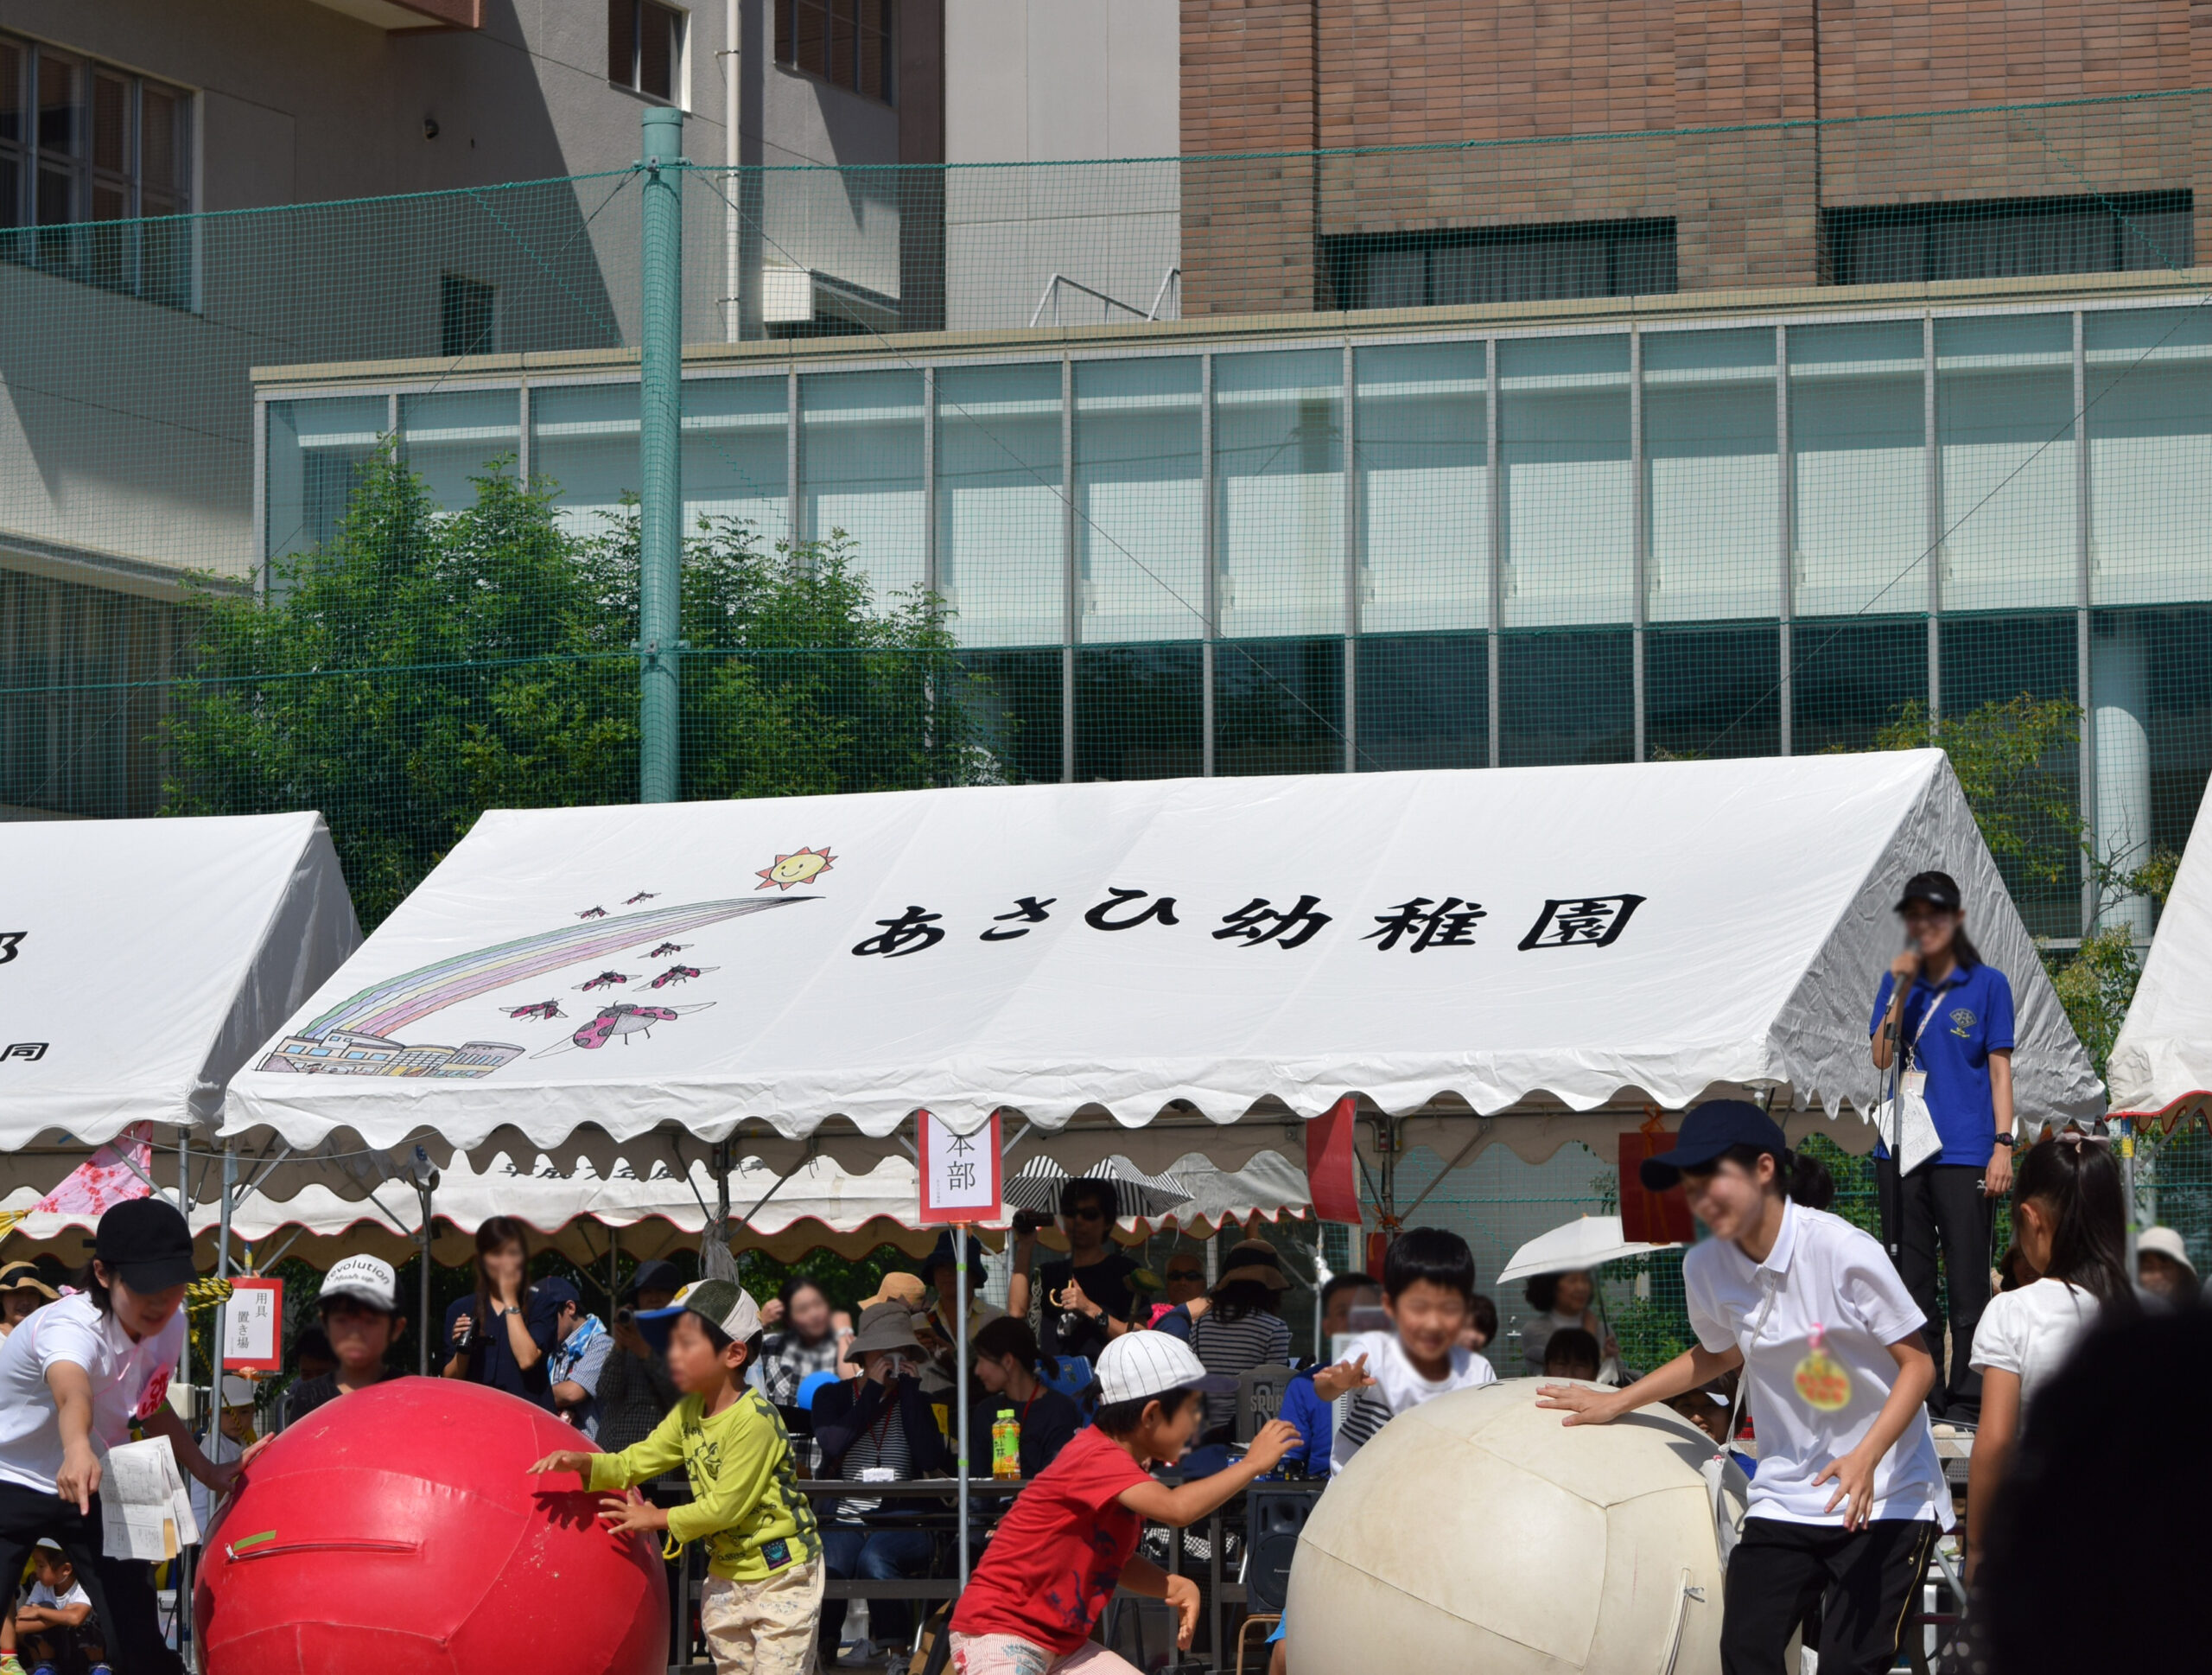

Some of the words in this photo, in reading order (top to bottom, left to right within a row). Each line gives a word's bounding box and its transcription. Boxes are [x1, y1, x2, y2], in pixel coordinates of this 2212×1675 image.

[851, 887, 1647, 959] あさひ幼稚園
[946, 1133, 976, 1190] 本部
[327, 1259, 391, 1284] revolution
[255, 1292, 268, 1318] 用具
[237, 1311, 250, 1349] 置き場
